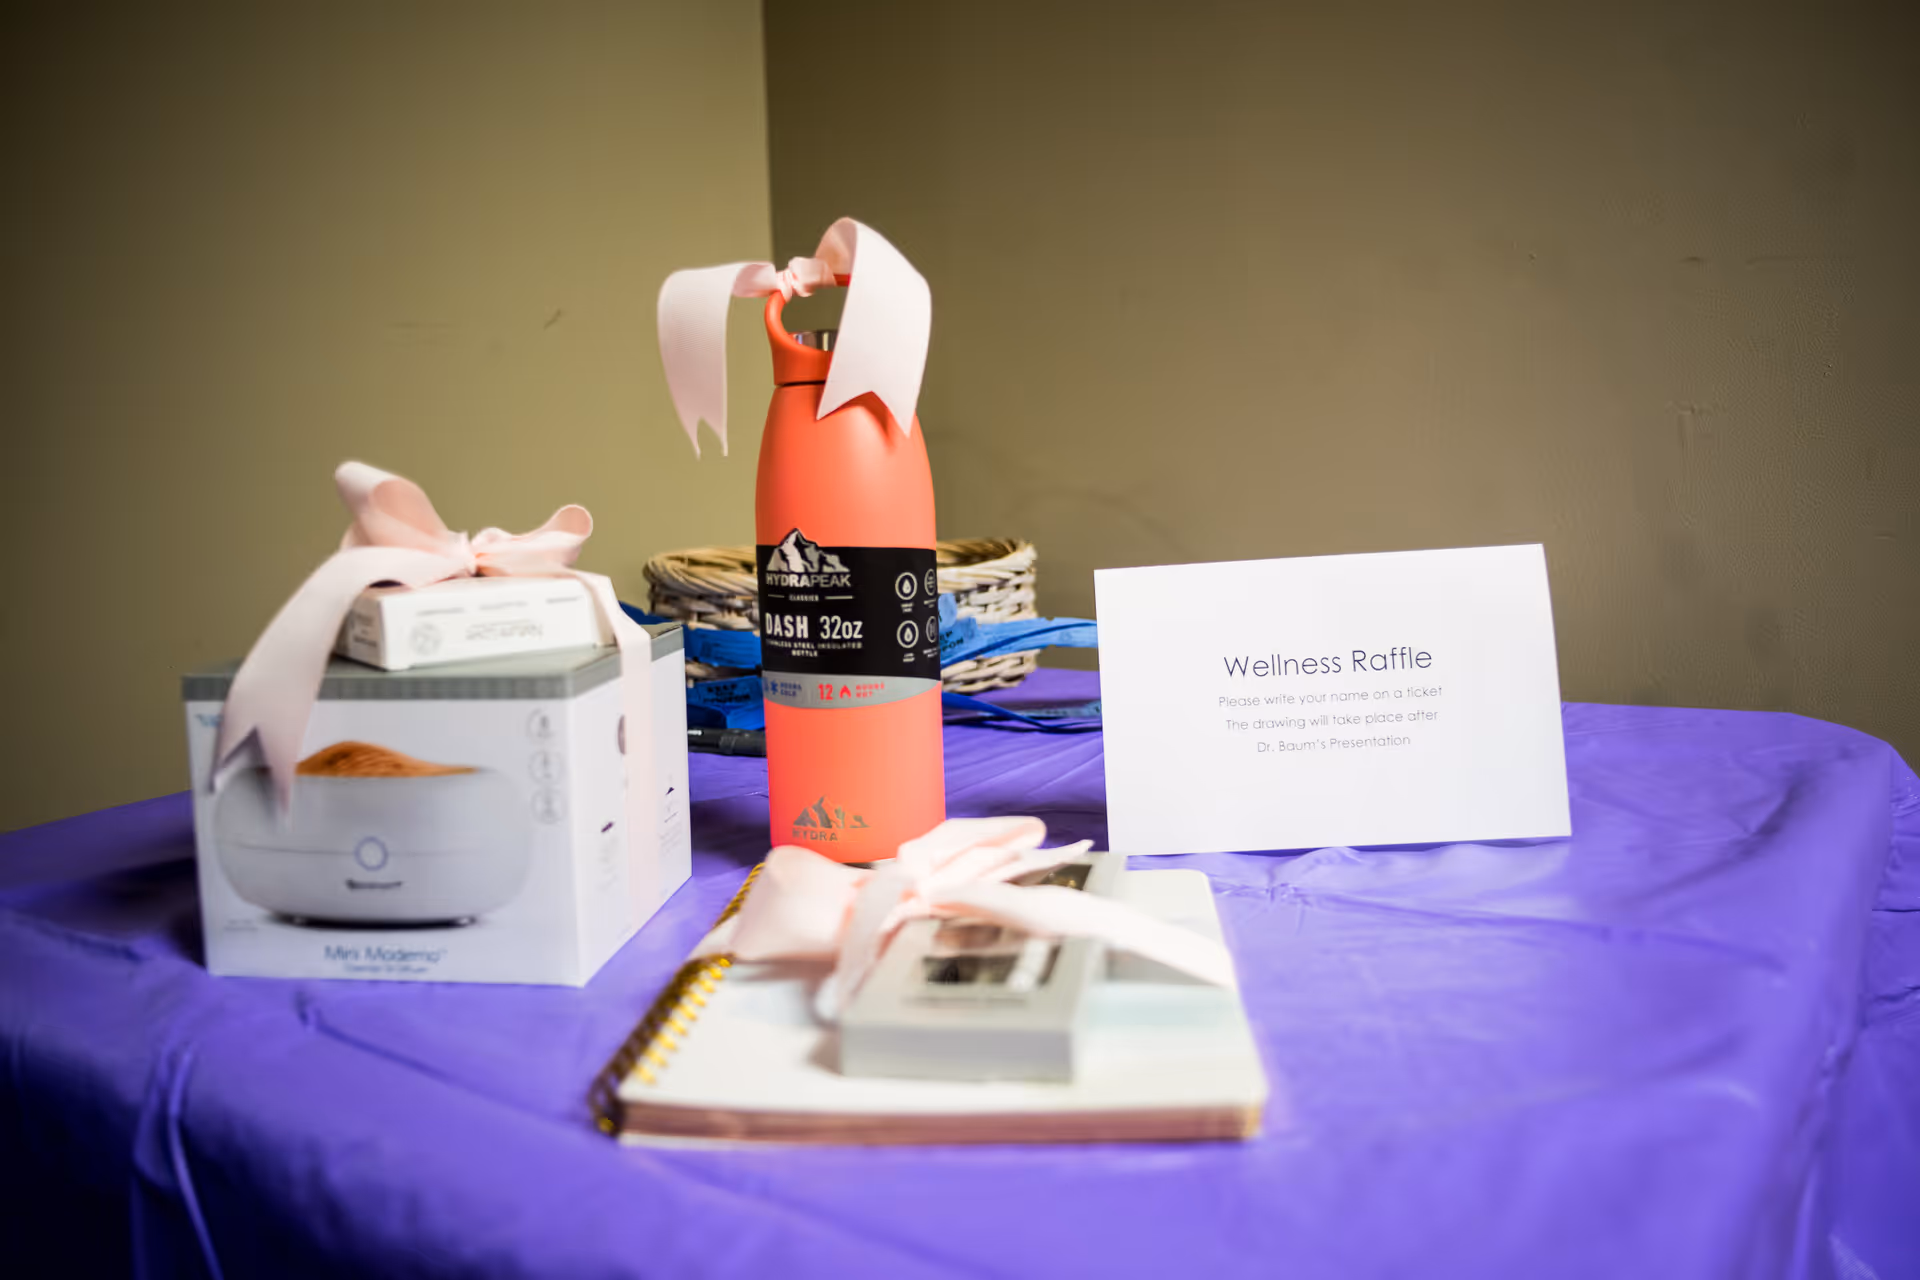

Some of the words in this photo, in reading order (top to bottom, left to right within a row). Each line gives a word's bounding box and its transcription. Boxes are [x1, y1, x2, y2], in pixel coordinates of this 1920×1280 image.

[766, 572, 851, 587] HYDRAPEAK
[765, 612, 809, 639] DASH
[791, 649, 818, 657] BOTTLE
[793, 641, 815, 650] STEEL
[1224, 654, 1341, 677] Wellness
[1352, 647, 1432, 672] Raffle
[818, 683, 833, 700] 12
[1219, 697, 1260, 707] Please
[1264, 694, 1295, 704] write
[1299, 694, 1326, 705] your
[1331, 692, 1368, 701] name
[1373, 691, 1389, 700] on
[1394, 690, 1402, 698] a
[1407, 686, 1442, 697] ticket
[1226, 720, 1248, 730] The
[1253, 717, 1305, 729] drawing
[1309, 715, 1328, 726] will
[1333, 715, 1360, 725] take
[1365, 713, 1403, 725] place
[1408, 710, 1438, 721] after
[1258, 742, 1274, 752] Dr.
[1279, 739, 1326, 751] Baum's
[1330, 735, 1410, 748] Presentation
[792, 828, 838, 842] HYDRA
